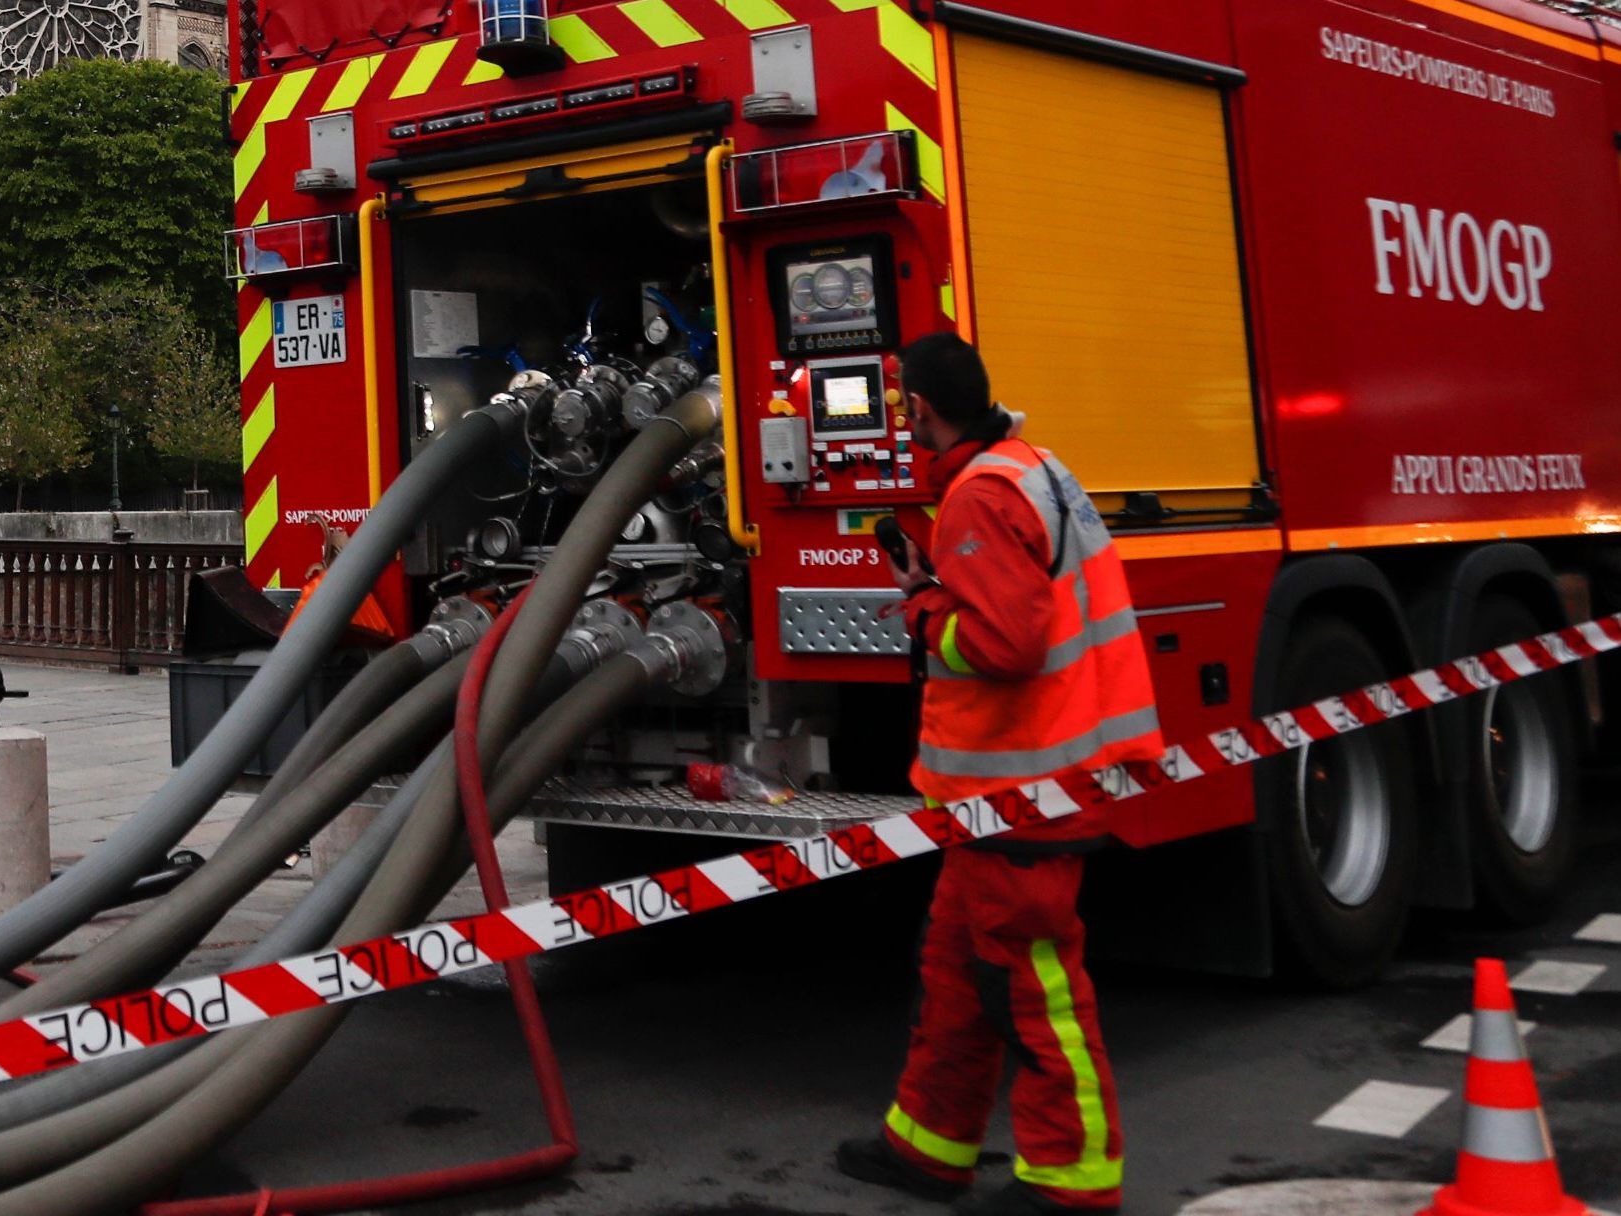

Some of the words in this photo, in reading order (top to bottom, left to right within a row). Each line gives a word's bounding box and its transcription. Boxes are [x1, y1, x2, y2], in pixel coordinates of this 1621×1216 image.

[1320, 27, 1487, 99] SAPEURS-POMPIERS
[1488, 74, 1511, 106] DE
[1512, 81, 1555, 118] PARIS
[1366, 197, 1552, 312] FMOGP
[332, 312, 343, 328] 75
[1391, 455, 1456, 494] APPUI
[1457, 455, 1536, 493] GRANDS
[1537, 454, 1586, 490] FEUX
[799, 548, 864, 566] FMOGP
[867, 548, 880, 565] 3
[38, 976, 230, 1067] POLICE
[313, 923, 478, 998] POLICE
[550, 869, 694, 944] POLICE
[756, 825, 879, 892] POLICE
